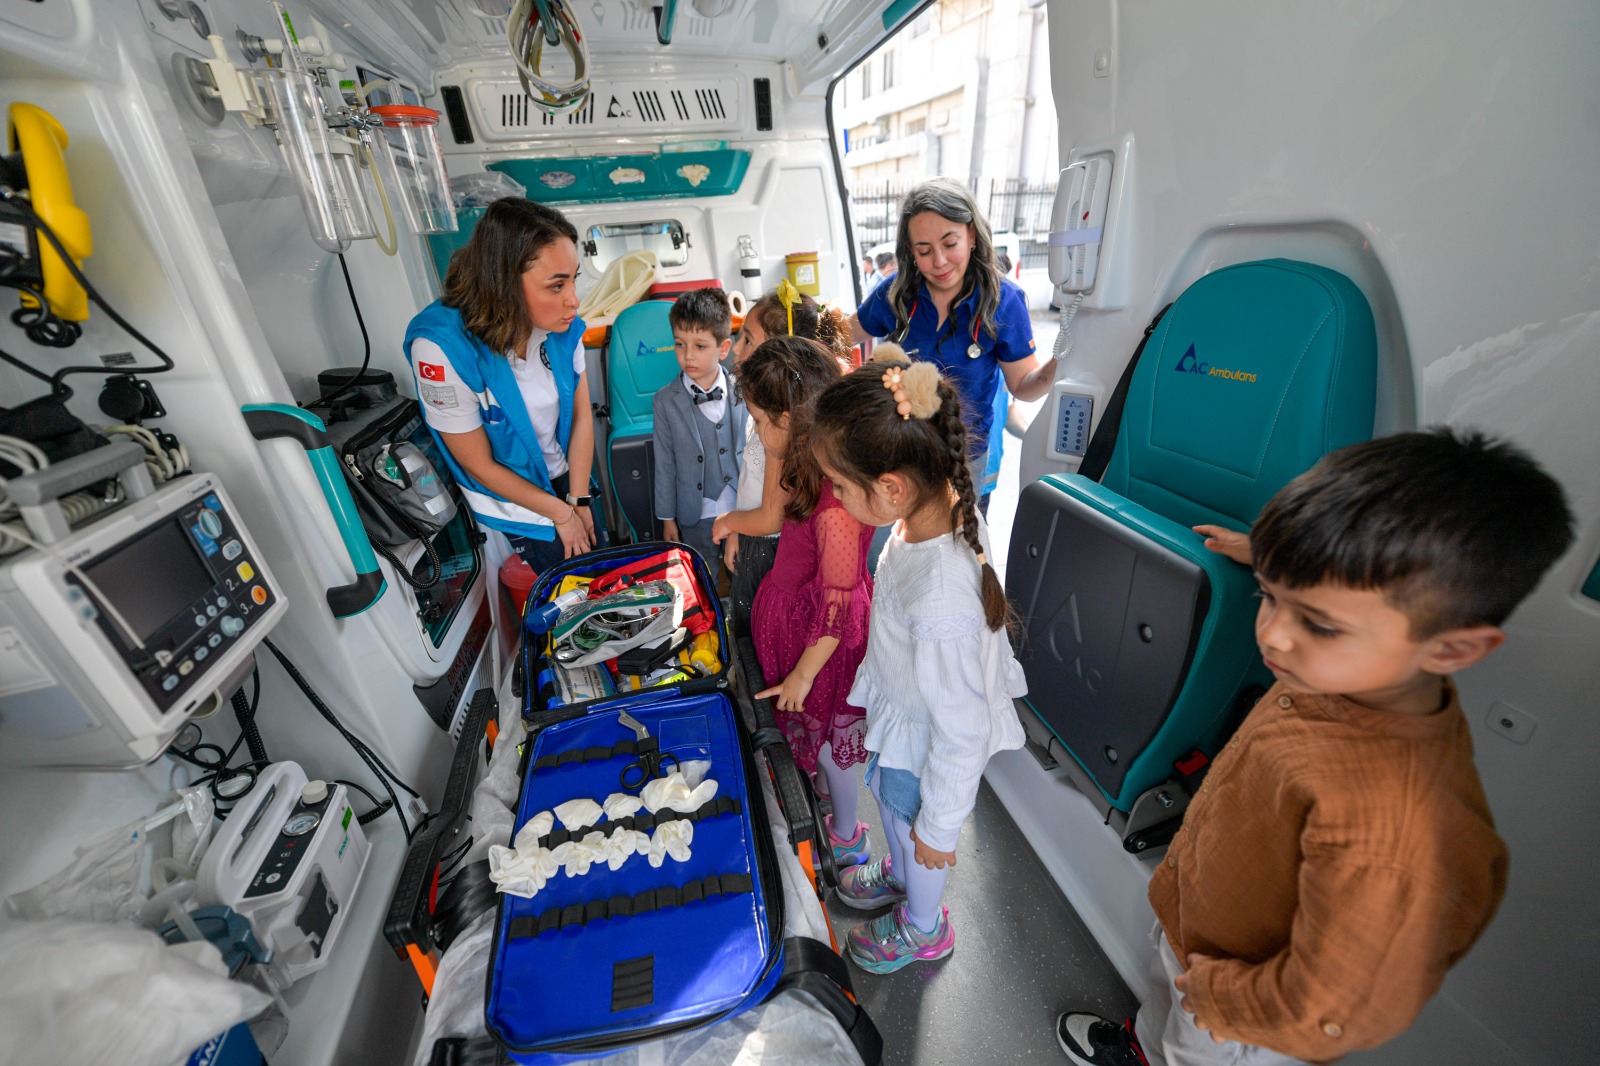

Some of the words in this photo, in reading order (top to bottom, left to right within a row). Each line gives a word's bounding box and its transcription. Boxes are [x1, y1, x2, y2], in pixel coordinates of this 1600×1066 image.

[1208, 366, 1257, 383] Ambulans
[225, 578, 236, 591] 2
[240, 603, 249, 615] 3
